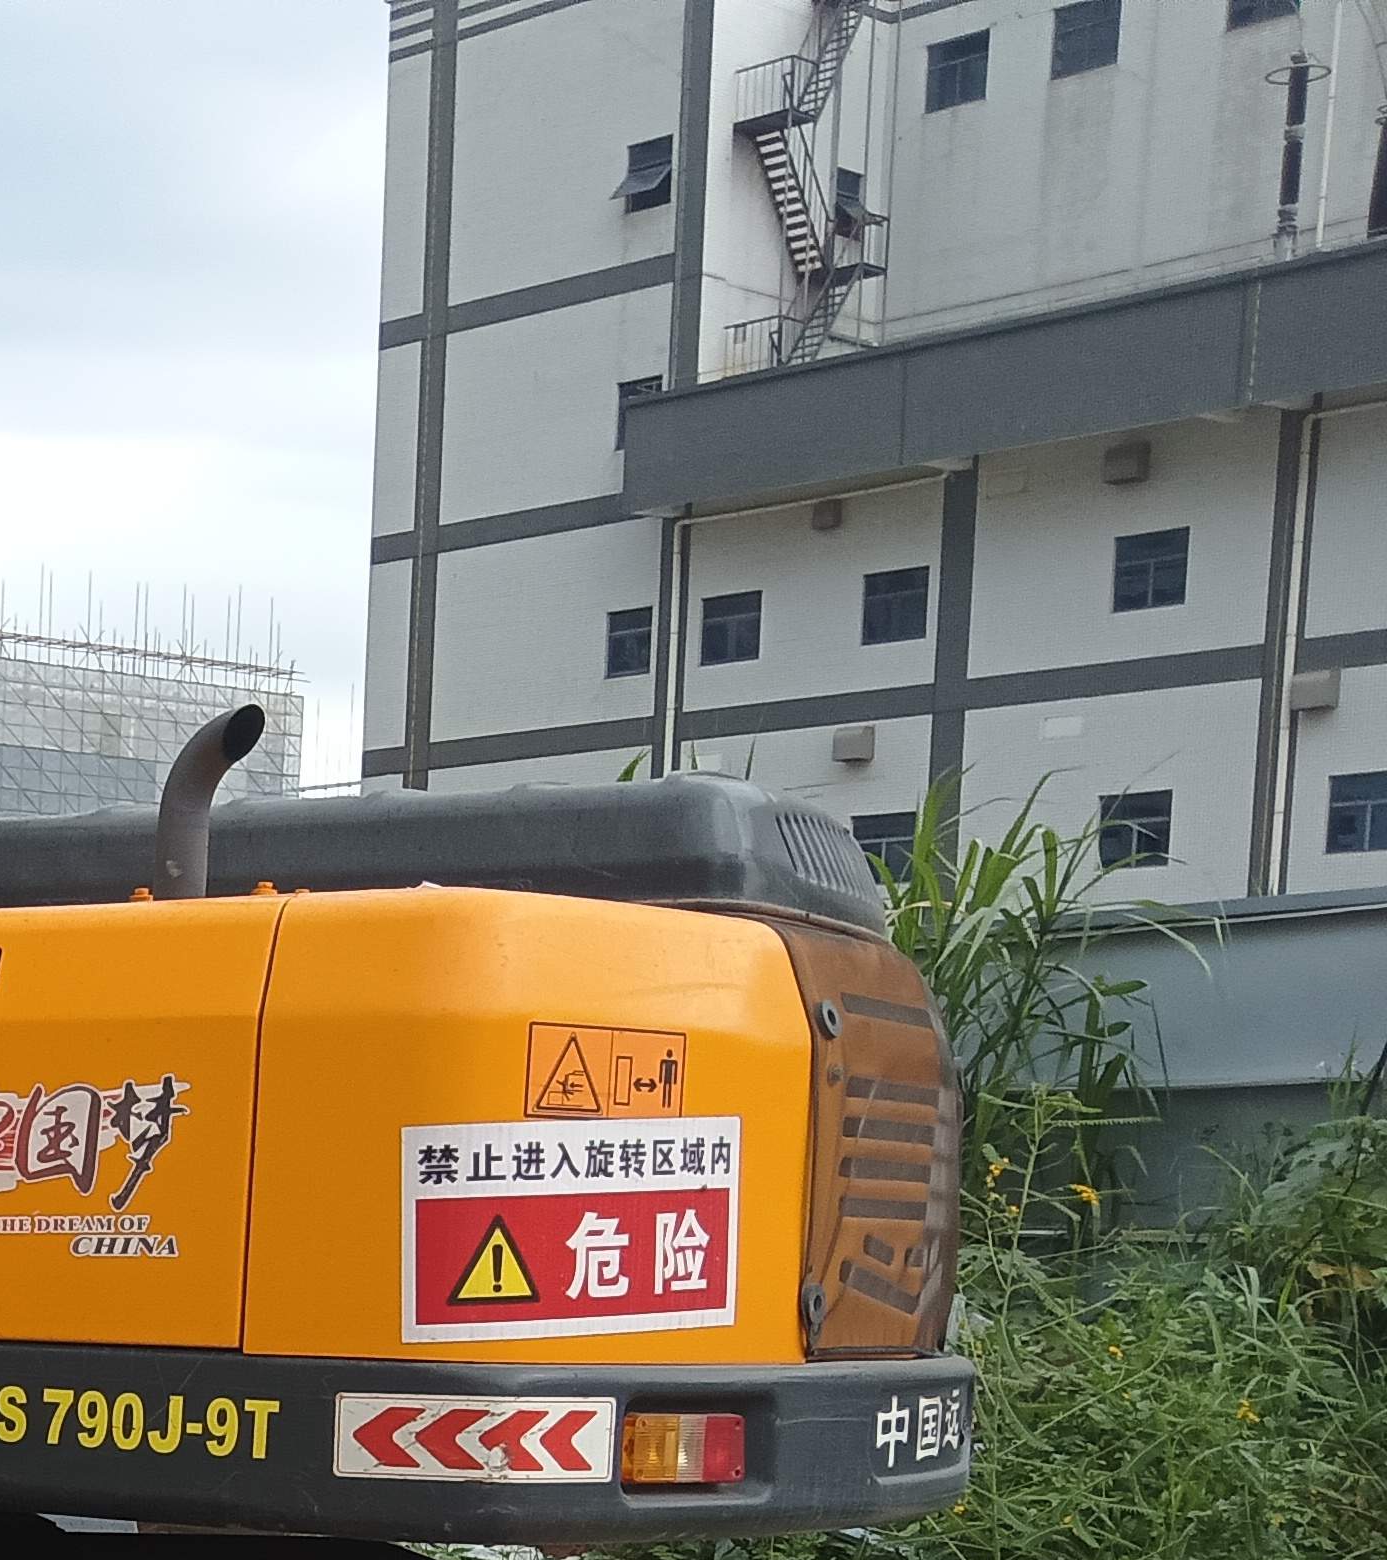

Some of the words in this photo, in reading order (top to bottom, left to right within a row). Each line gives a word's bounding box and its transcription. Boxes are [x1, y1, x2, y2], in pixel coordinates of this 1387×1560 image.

[417, 1136, 732, 1186] 禁止进入旋转区域内
[36, 1217, 113, 1232] DREAM
[119, 1216, 149, 1232] OF
[71, 1236, 177, 1255] CHINA
[565, 1208, 711, 1300] 危险
[42, 1387, 281, 1460] 790J-9T
